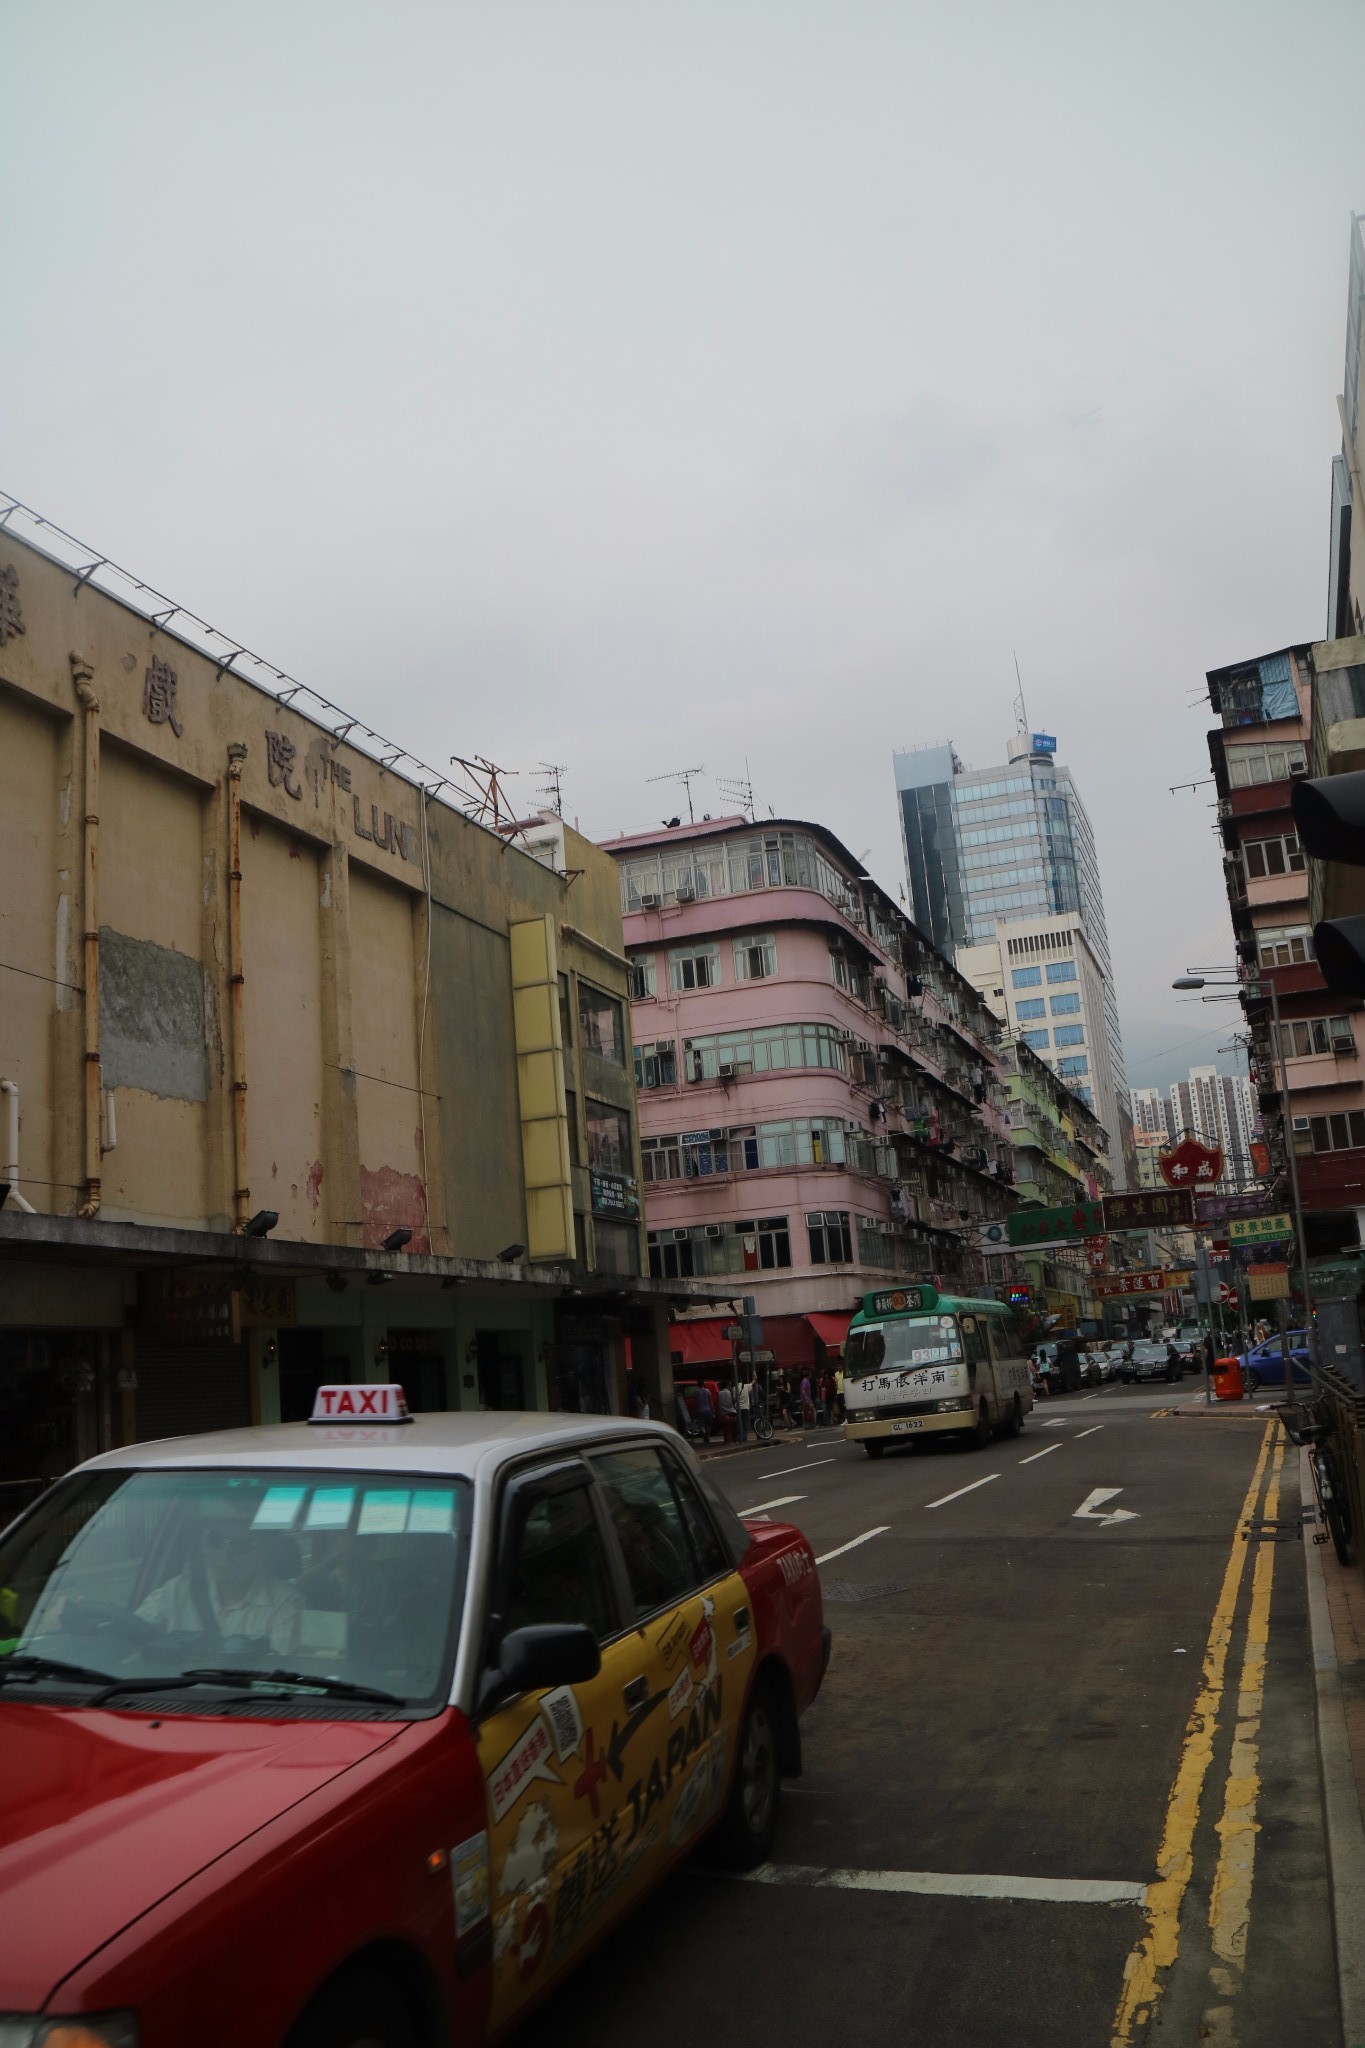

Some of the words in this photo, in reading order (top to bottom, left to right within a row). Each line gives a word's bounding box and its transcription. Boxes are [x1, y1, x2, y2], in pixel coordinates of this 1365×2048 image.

[320, 753, 352, 794] THE
[1234, 1217, 1287, 1234] 好景地產
[1091, 1251, 1105, 1265] 押
[914, 1350, 931, 1363] 93
[321, 1390, 387, 1414] TAXI
[906, 1421, 923, 1429] 1622
